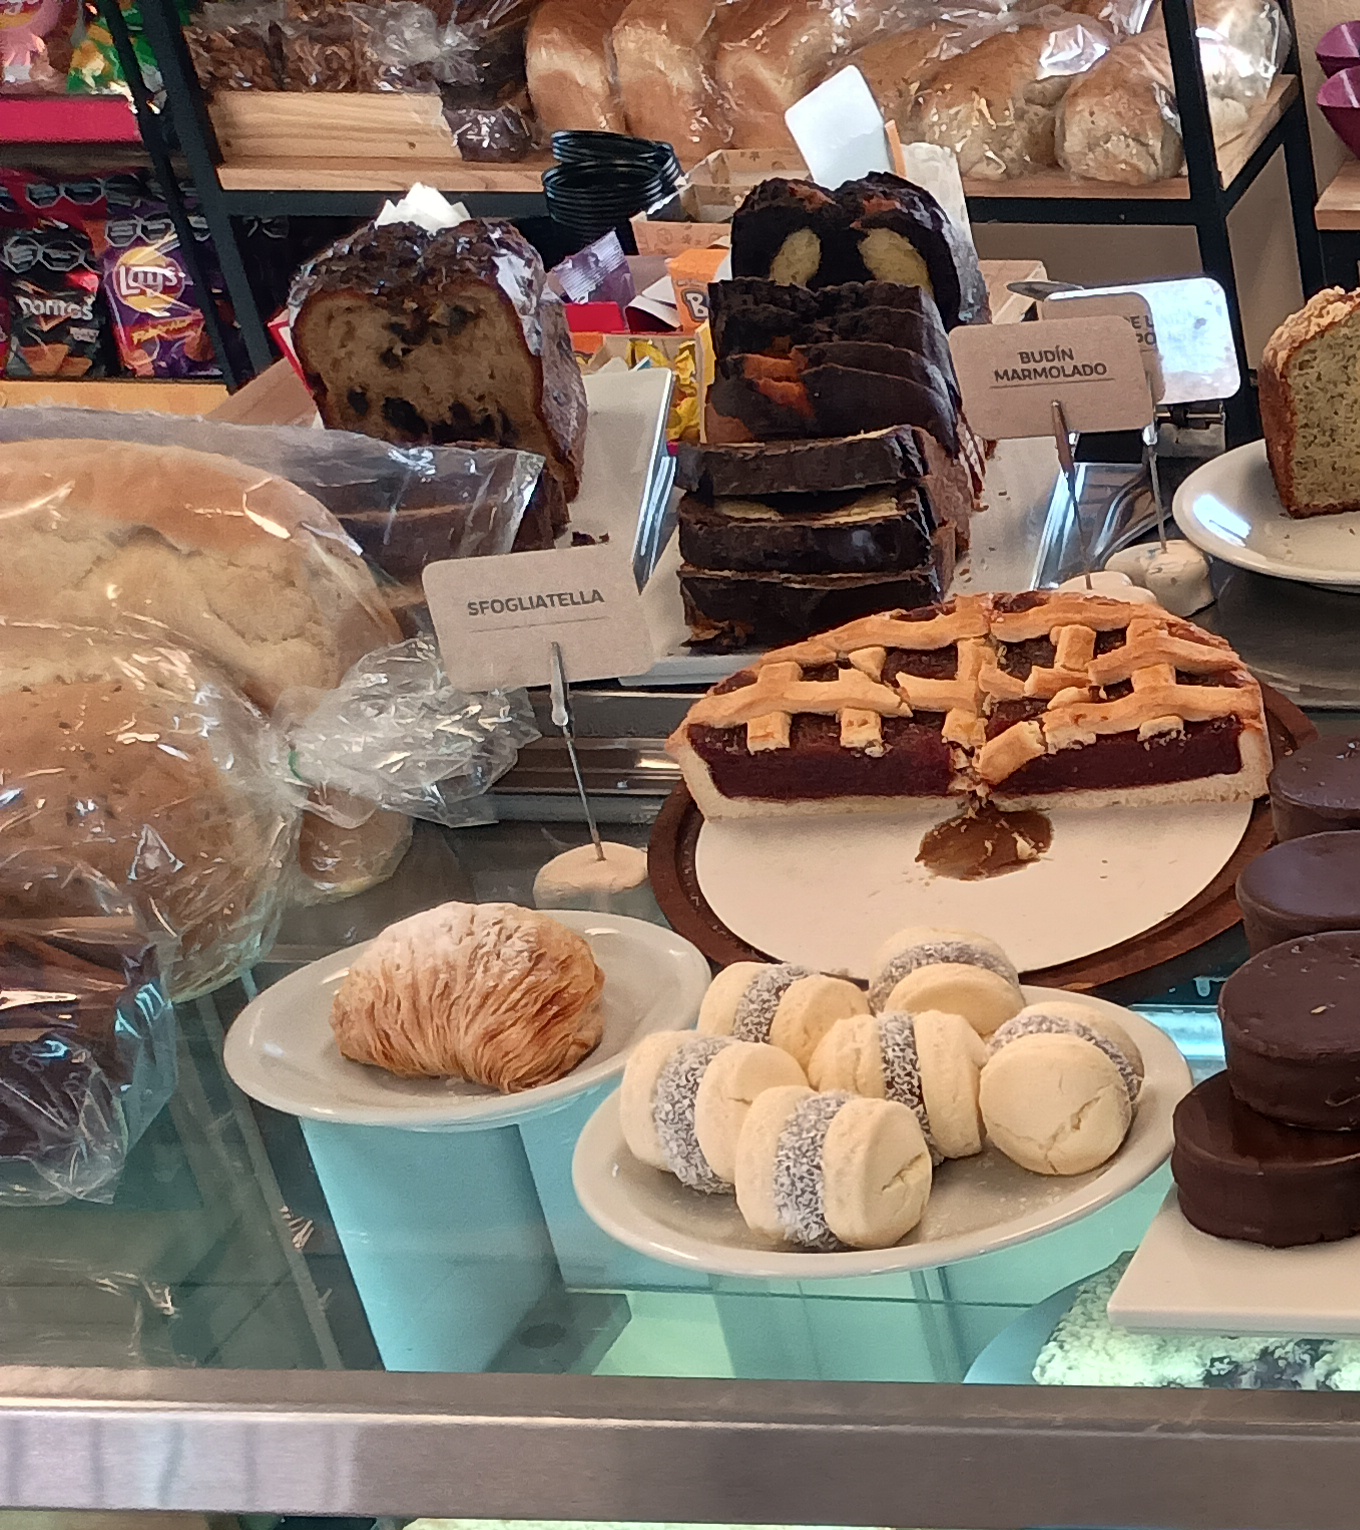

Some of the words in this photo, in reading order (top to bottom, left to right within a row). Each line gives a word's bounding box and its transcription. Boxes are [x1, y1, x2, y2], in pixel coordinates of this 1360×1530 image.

[1017, 345, 1075, 364] BUDÍN
[993, 362, 1108, 382] MARMOLADO
[467, 589, 605, 616] SFOGLIATELLA
